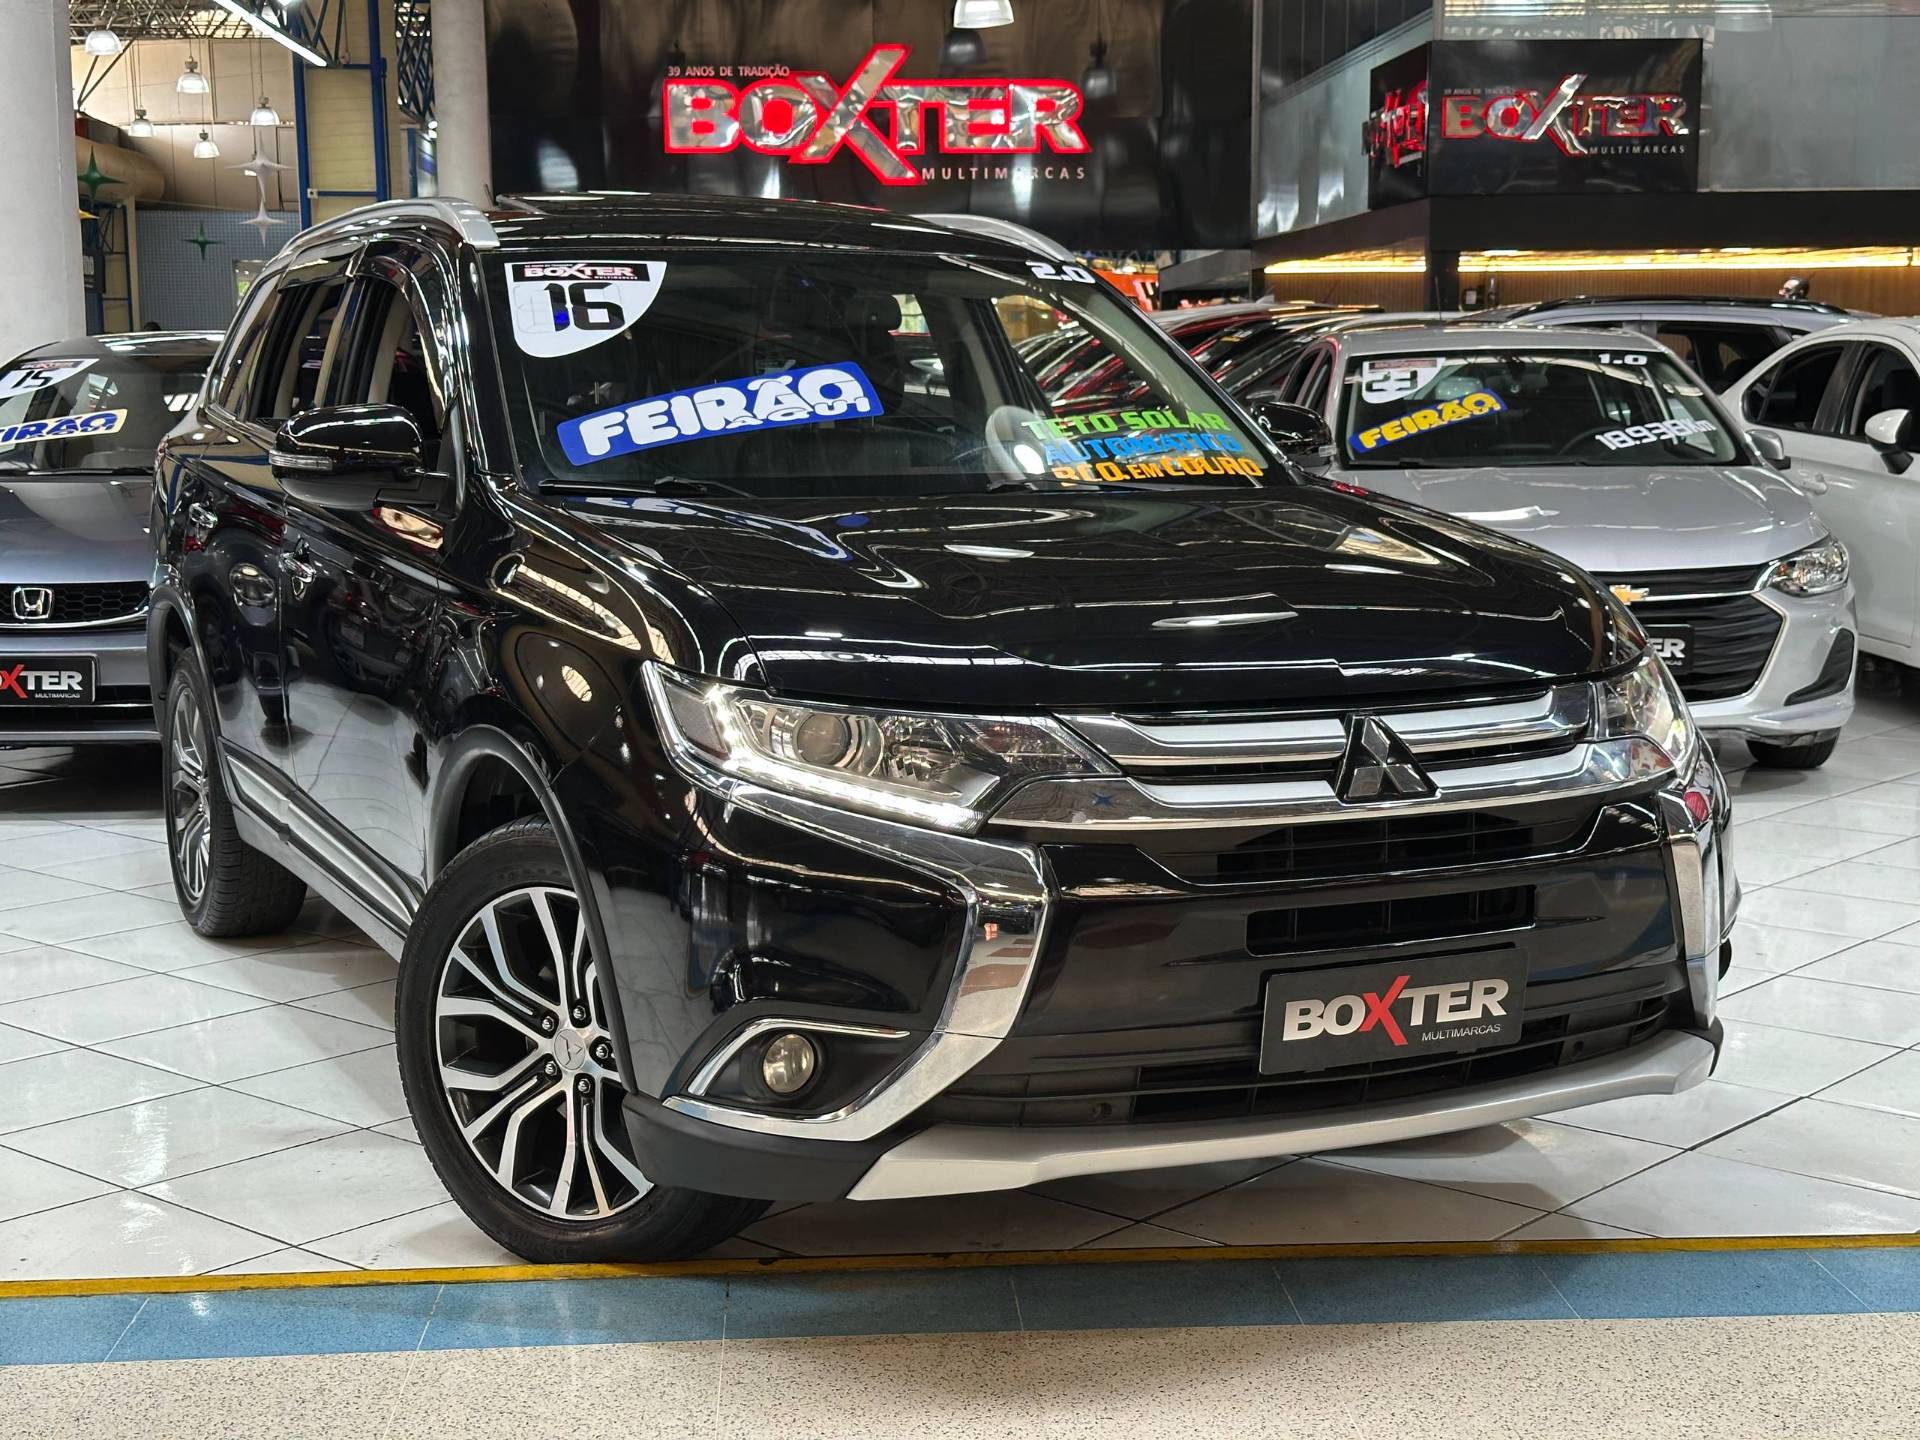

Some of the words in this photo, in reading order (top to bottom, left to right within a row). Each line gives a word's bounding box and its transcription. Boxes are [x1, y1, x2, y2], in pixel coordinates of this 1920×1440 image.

[668, 66, 680, 77] 39
[685, 66, 715, 76] ANOS
[720, 66, 733, 76] DE
[738, 64, 790, 78] TRADIÇÃO
[662, 43, 1092, 186] BOXTER
[1441, 73, 1689, 157] BOXTER
[1589, 145, 1686, 155] MULTIMARCAS
[922, 166, 1087, 181] MULTIMRCAS
[524, 263, 636, 279] BOXTER
[1025, 261, 1096, 284] 2.0
[544, 282, 626, 332] 16
[1598, 353, 1647, 366] 1.0
[579, 368, 870, 457] FEIRÃO
[1021, 413, 1119, 441] TETO
[1121, 410, 1232, 431] SOLAR
[1357, 391, 1501, 450] FEIRÃO
[0, 412, 118, 443] IRÃO
[1127, 462, 1166, 479] EM
[1160, 455, 1264, 478] COURO
[1282, 974, 1509, 1047] BOXTER
[1421, 1022, 1502, 1042] MULTIMARCAS
